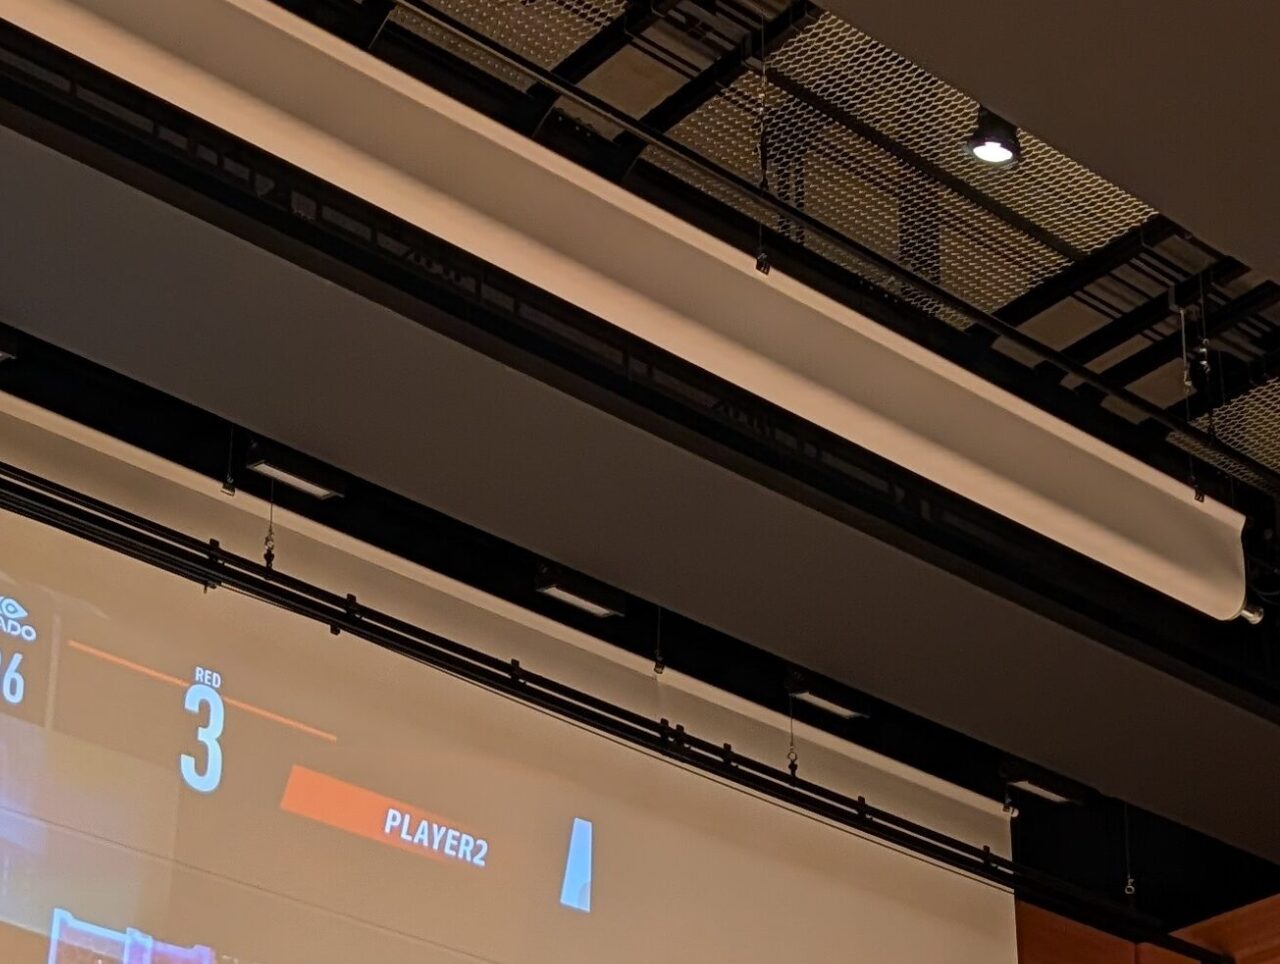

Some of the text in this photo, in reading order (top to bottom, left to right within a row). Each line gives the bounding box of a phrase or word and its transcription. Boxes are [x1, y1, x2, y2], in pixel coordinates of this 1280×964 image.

[195, 666, 222, 688] RED
[180, 683, 225, 793] 3
[384, 808, 489, 867] PLAYER2
